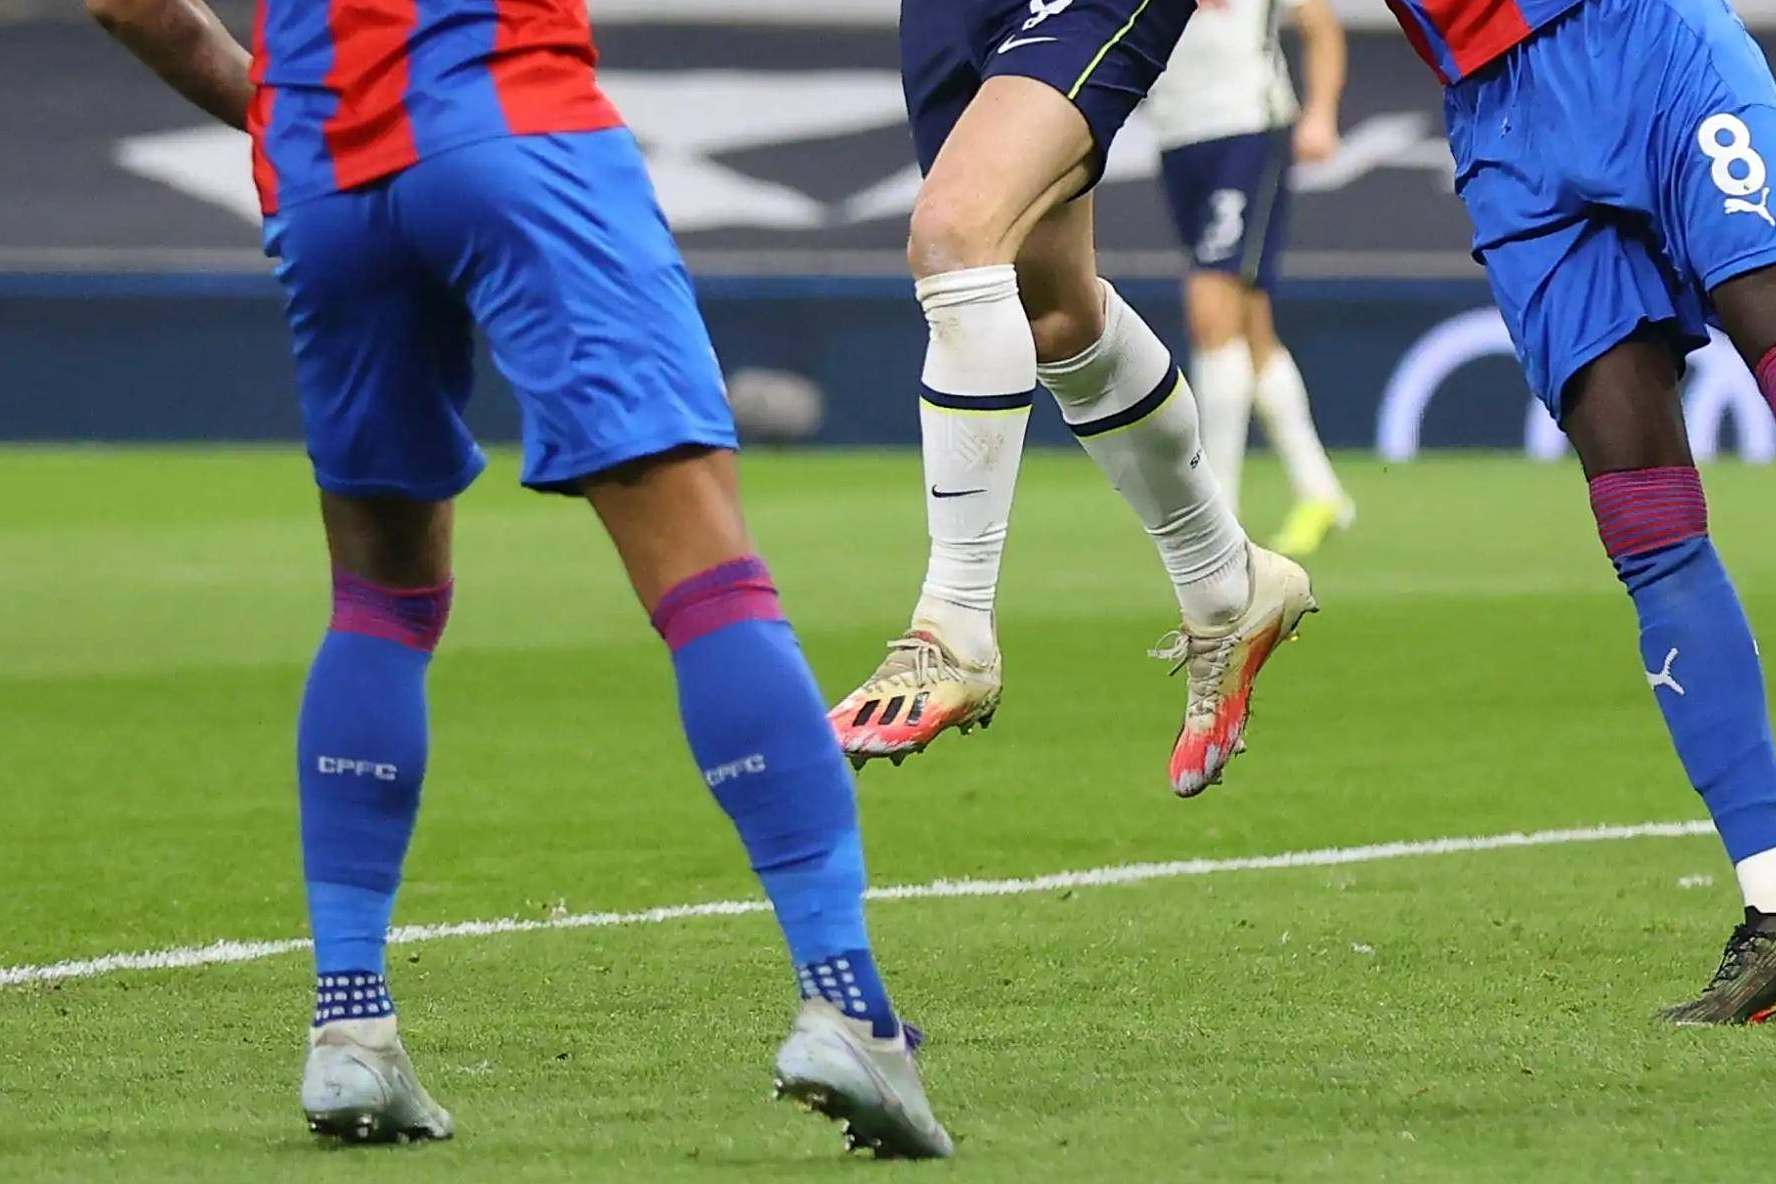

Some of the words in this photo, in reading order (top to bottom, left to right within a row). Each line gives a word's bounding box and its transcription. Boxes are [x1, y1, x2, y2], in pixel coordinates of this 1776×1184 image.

[1699, 112, 1767, 197] 8
[318, 754, 398, 782] CPFC
[704, 753, 767, 787] CPFC
